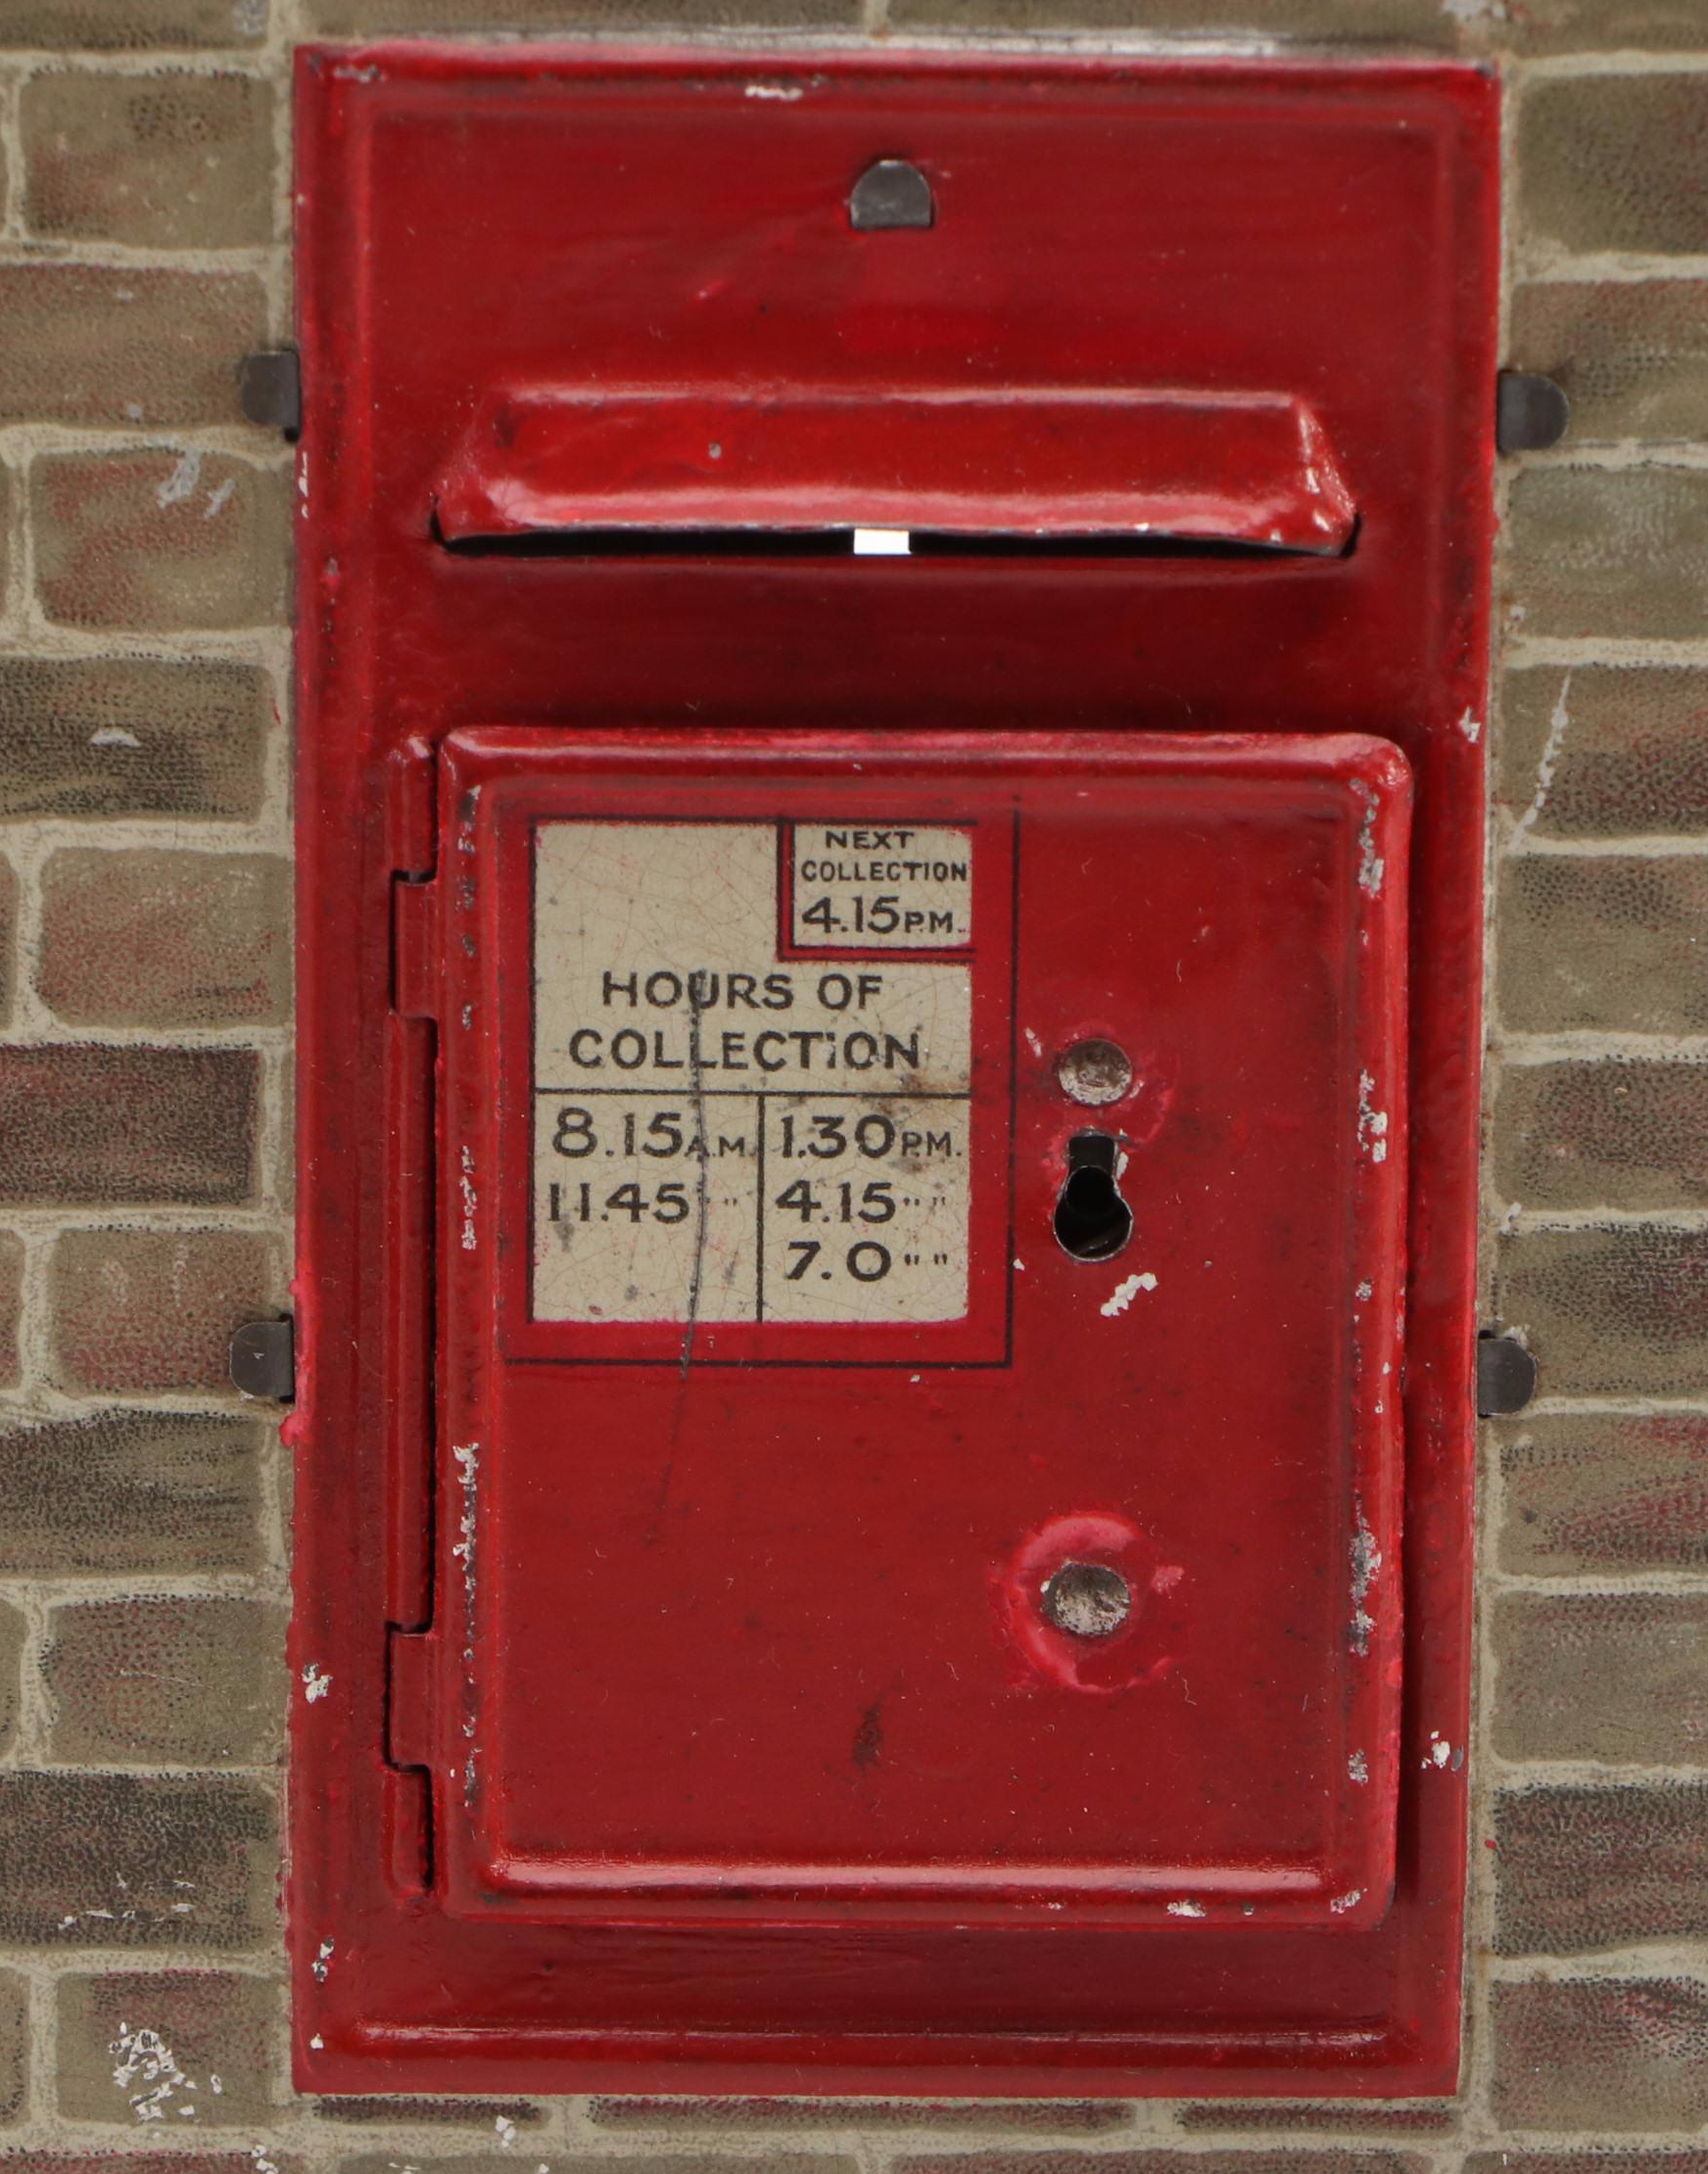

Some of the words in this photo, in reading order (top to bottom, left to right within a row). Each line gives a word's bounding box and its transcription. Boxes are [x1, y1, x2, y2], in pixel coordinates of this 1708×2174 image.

[826, 830, 915, 850] NEXT
[801, 859, 968, 882] COLLECTION
[601, 969, 795, 1010] HOURS
[817, 972, 883, 1010] OF
[568, 1028, 921, 1072] COLLECTION
[548, 1182, 690, 1224] 11.45
[775, 1179, 896, 1224] 4.15
